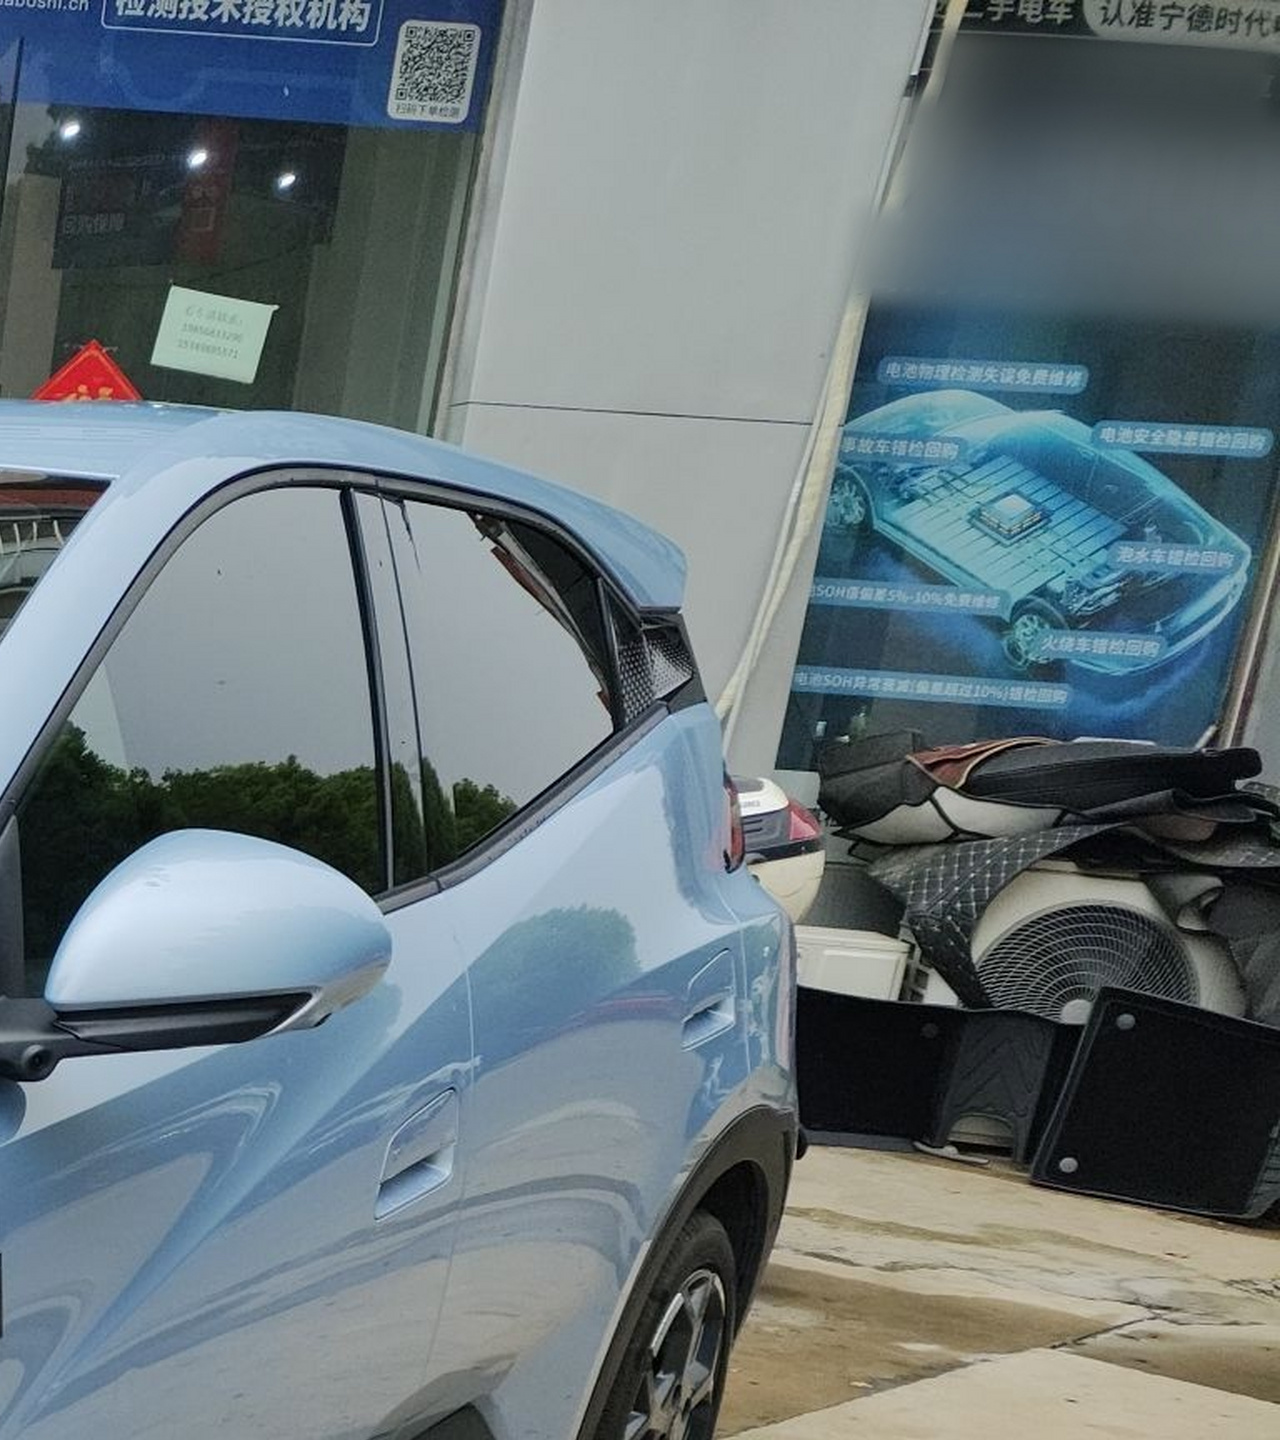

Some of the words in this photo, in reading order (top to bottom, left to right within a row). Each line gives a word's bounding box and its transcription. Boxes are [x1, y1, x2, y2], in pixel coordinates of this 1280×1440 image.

[115, 0, 370, 32] 检测技术授权机构
[1100, 0, 1280, 37] 认准宁德时代
